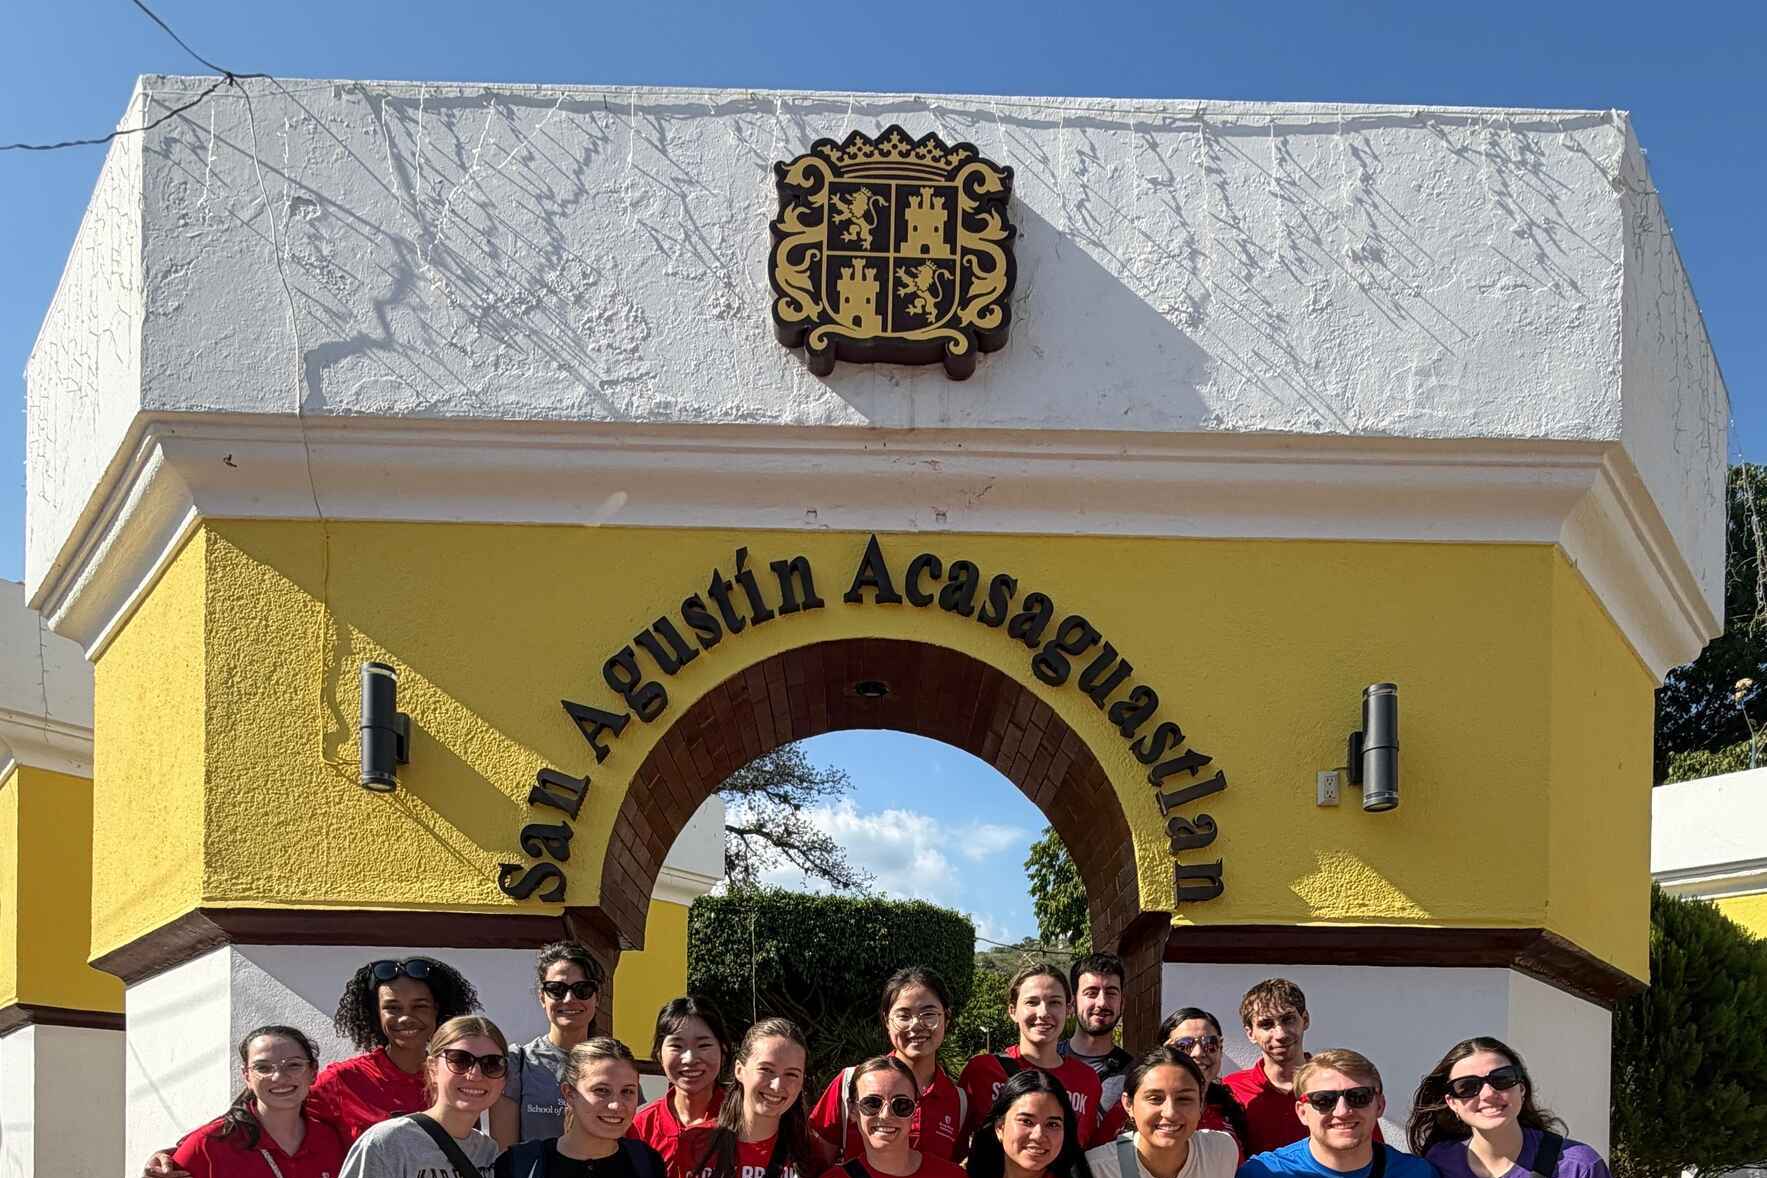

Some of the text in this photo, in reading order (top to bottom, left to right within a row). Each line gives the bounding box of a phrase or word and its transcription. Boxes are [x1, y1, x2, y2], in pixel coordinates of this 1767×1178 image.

[498, 533, 1228, 909] San Agustín Acasaguastlan
[527, 1103, 553, 1114] School
